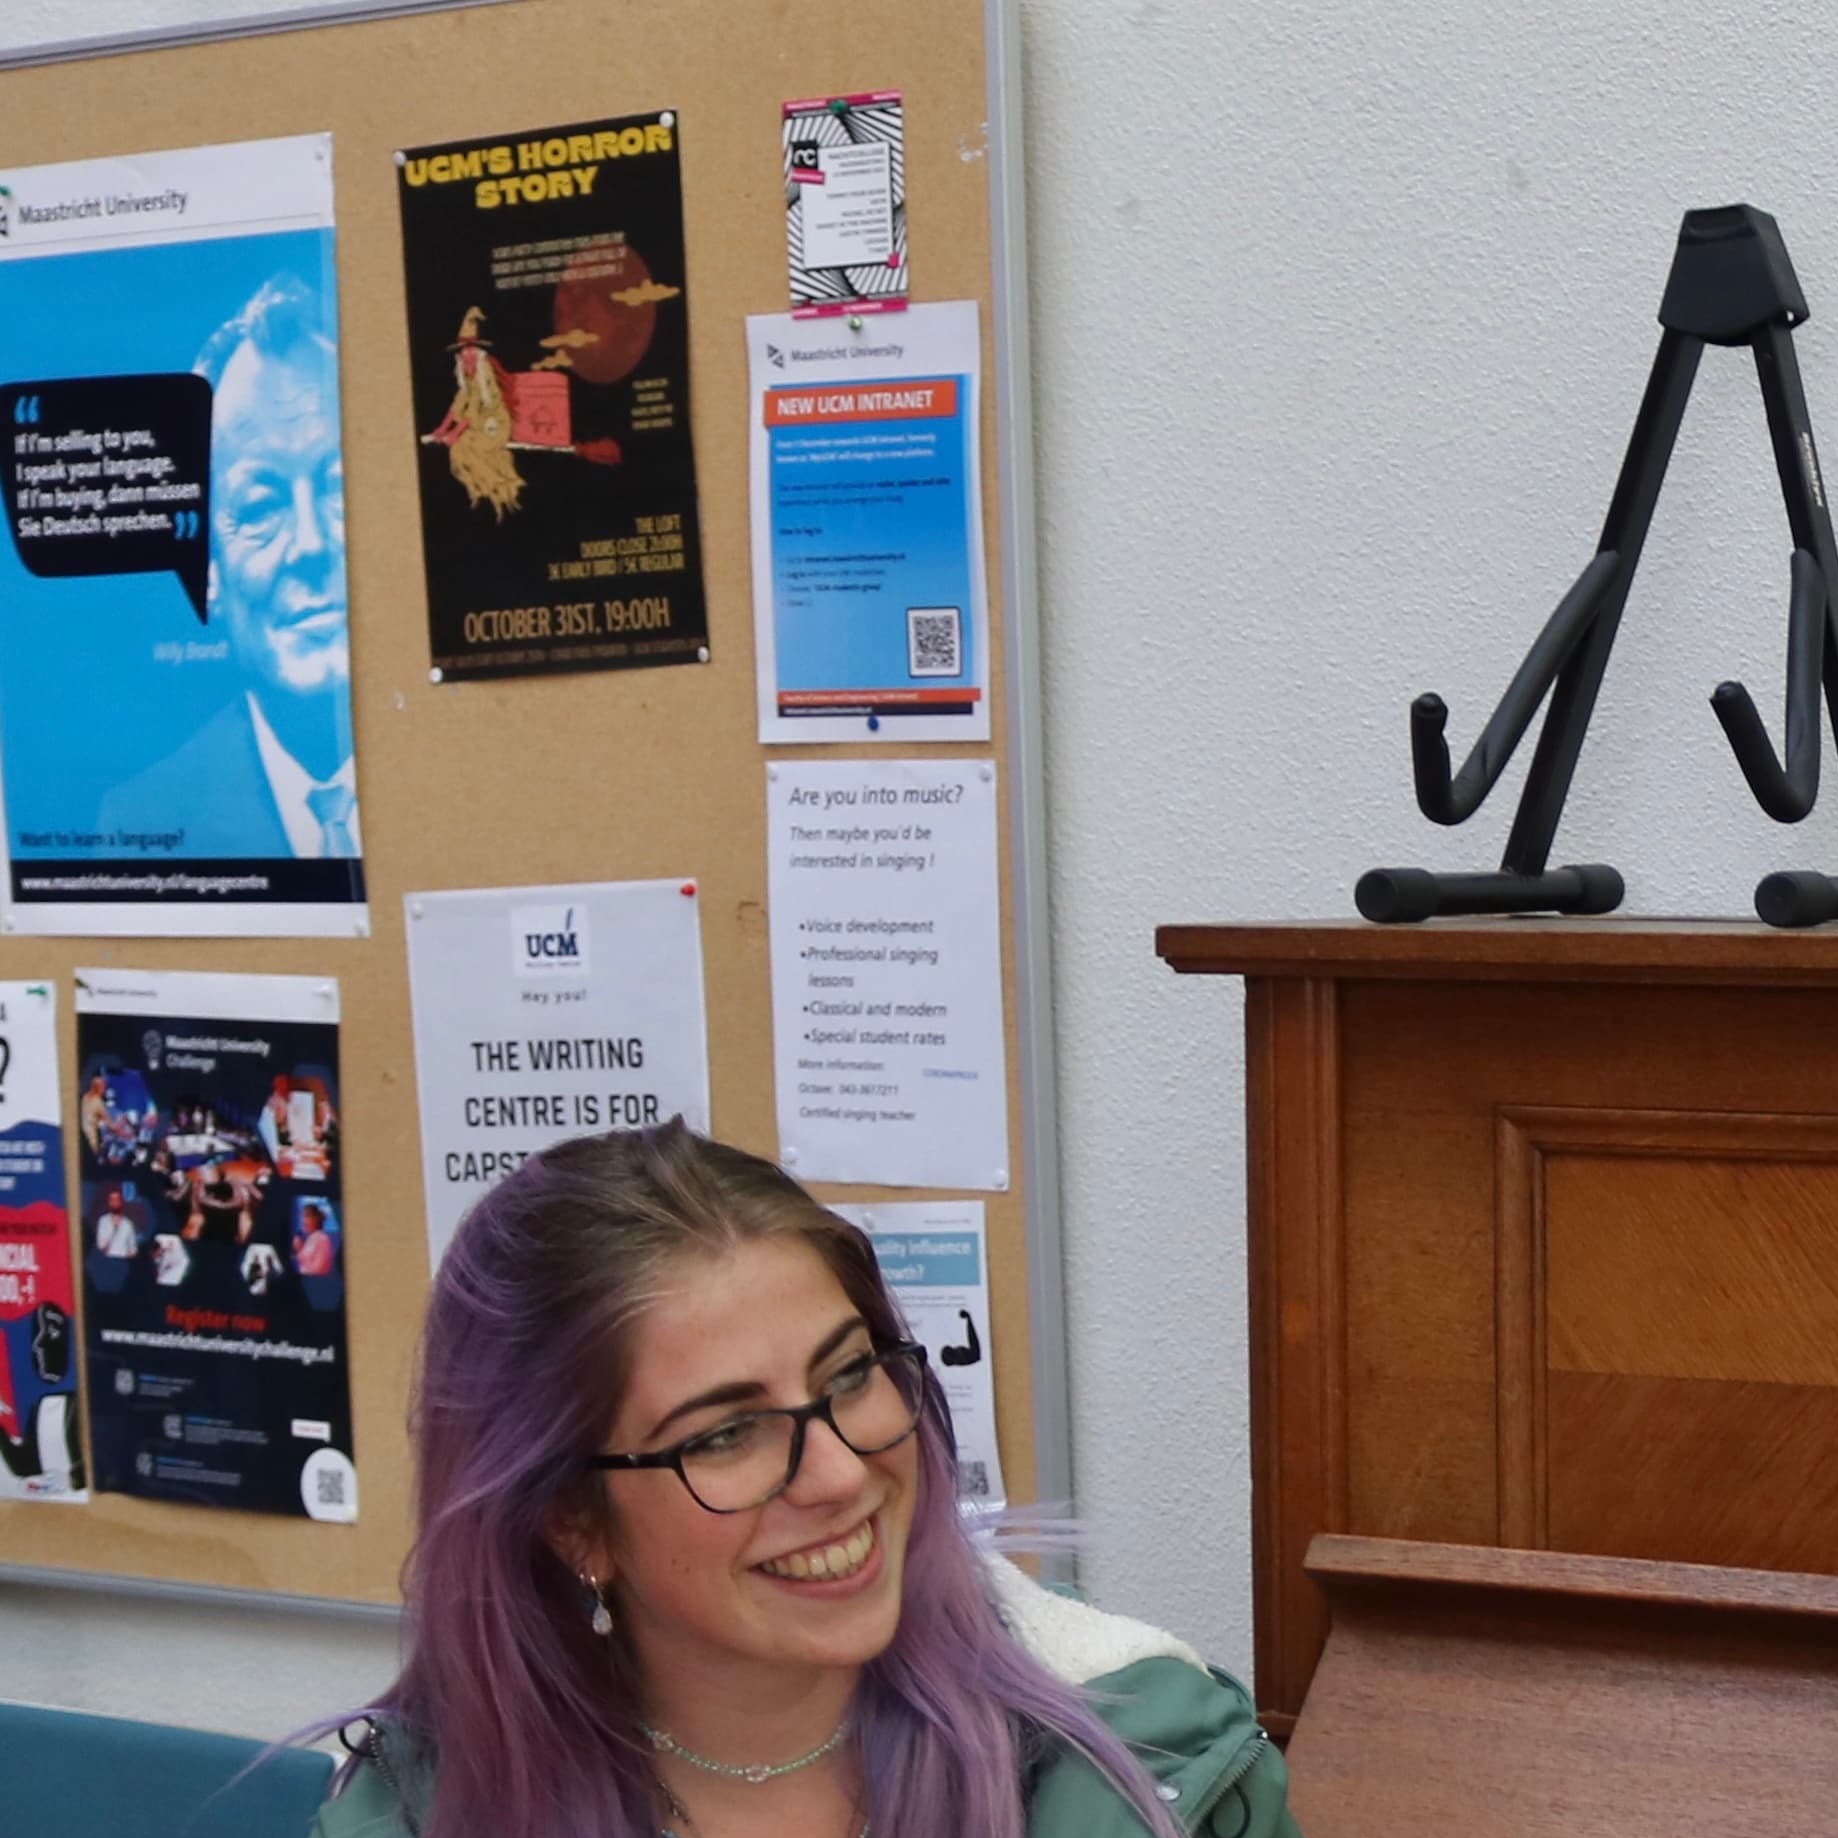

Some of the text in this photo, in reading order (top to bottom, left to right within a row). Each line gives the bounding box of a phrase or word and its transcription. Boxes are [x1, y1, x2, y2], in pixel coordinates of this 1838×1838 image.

[517, 124, 673, 170] HORROR
[474, 166, 598, 209] STORY
[18, 189, 188, 225] Maastricht University
[790, 344, 904, 362] Maastricht University
[777, 389, 934, 416] NEW UCM INTRANET
[54, 430, 103, 455] selling
[104, 429, 121, 448] to
[24, 459, 66, 486] speak
[67, 462, 102, 484] your
[107, 483, 144, 504] dann
[463, 606, 551, 643] OCTOBER
[787, 783, 964, 810] Are you into music?
[19, 832, 52, 848] Want
[53, 832, 69, 848] to
[72, 831, 107, 847] learn
[117, 827, 186, 851] language?
[788, 826, 822, 842] Then
[825, 827, 869, 845] maybe
[914, 826, 933, 840] be
[788, 853, 857, 869] interested
[859, 854, 874, 869] in
[875, 854, 926, 872] singing
[845, 918, 935, 936] development
[525, 932, 580, 958] UCM
[889, 946, 940, 966] singing
[808, 973, 855, 988] lessons
[865, 1002, 891, 1016] and
[894, 1002, 947, 1017] modern
[220, 1037, 271, 1057] University
[858, 1029, 910, 1046] student
[912, 1031, 947, 1046] rates
[471, 1037, 644, 1073] THE WRITING
[464, 1093, 660, 1128] CENTRE IS FOR
[166, 1304, 267, 1332] Register now
